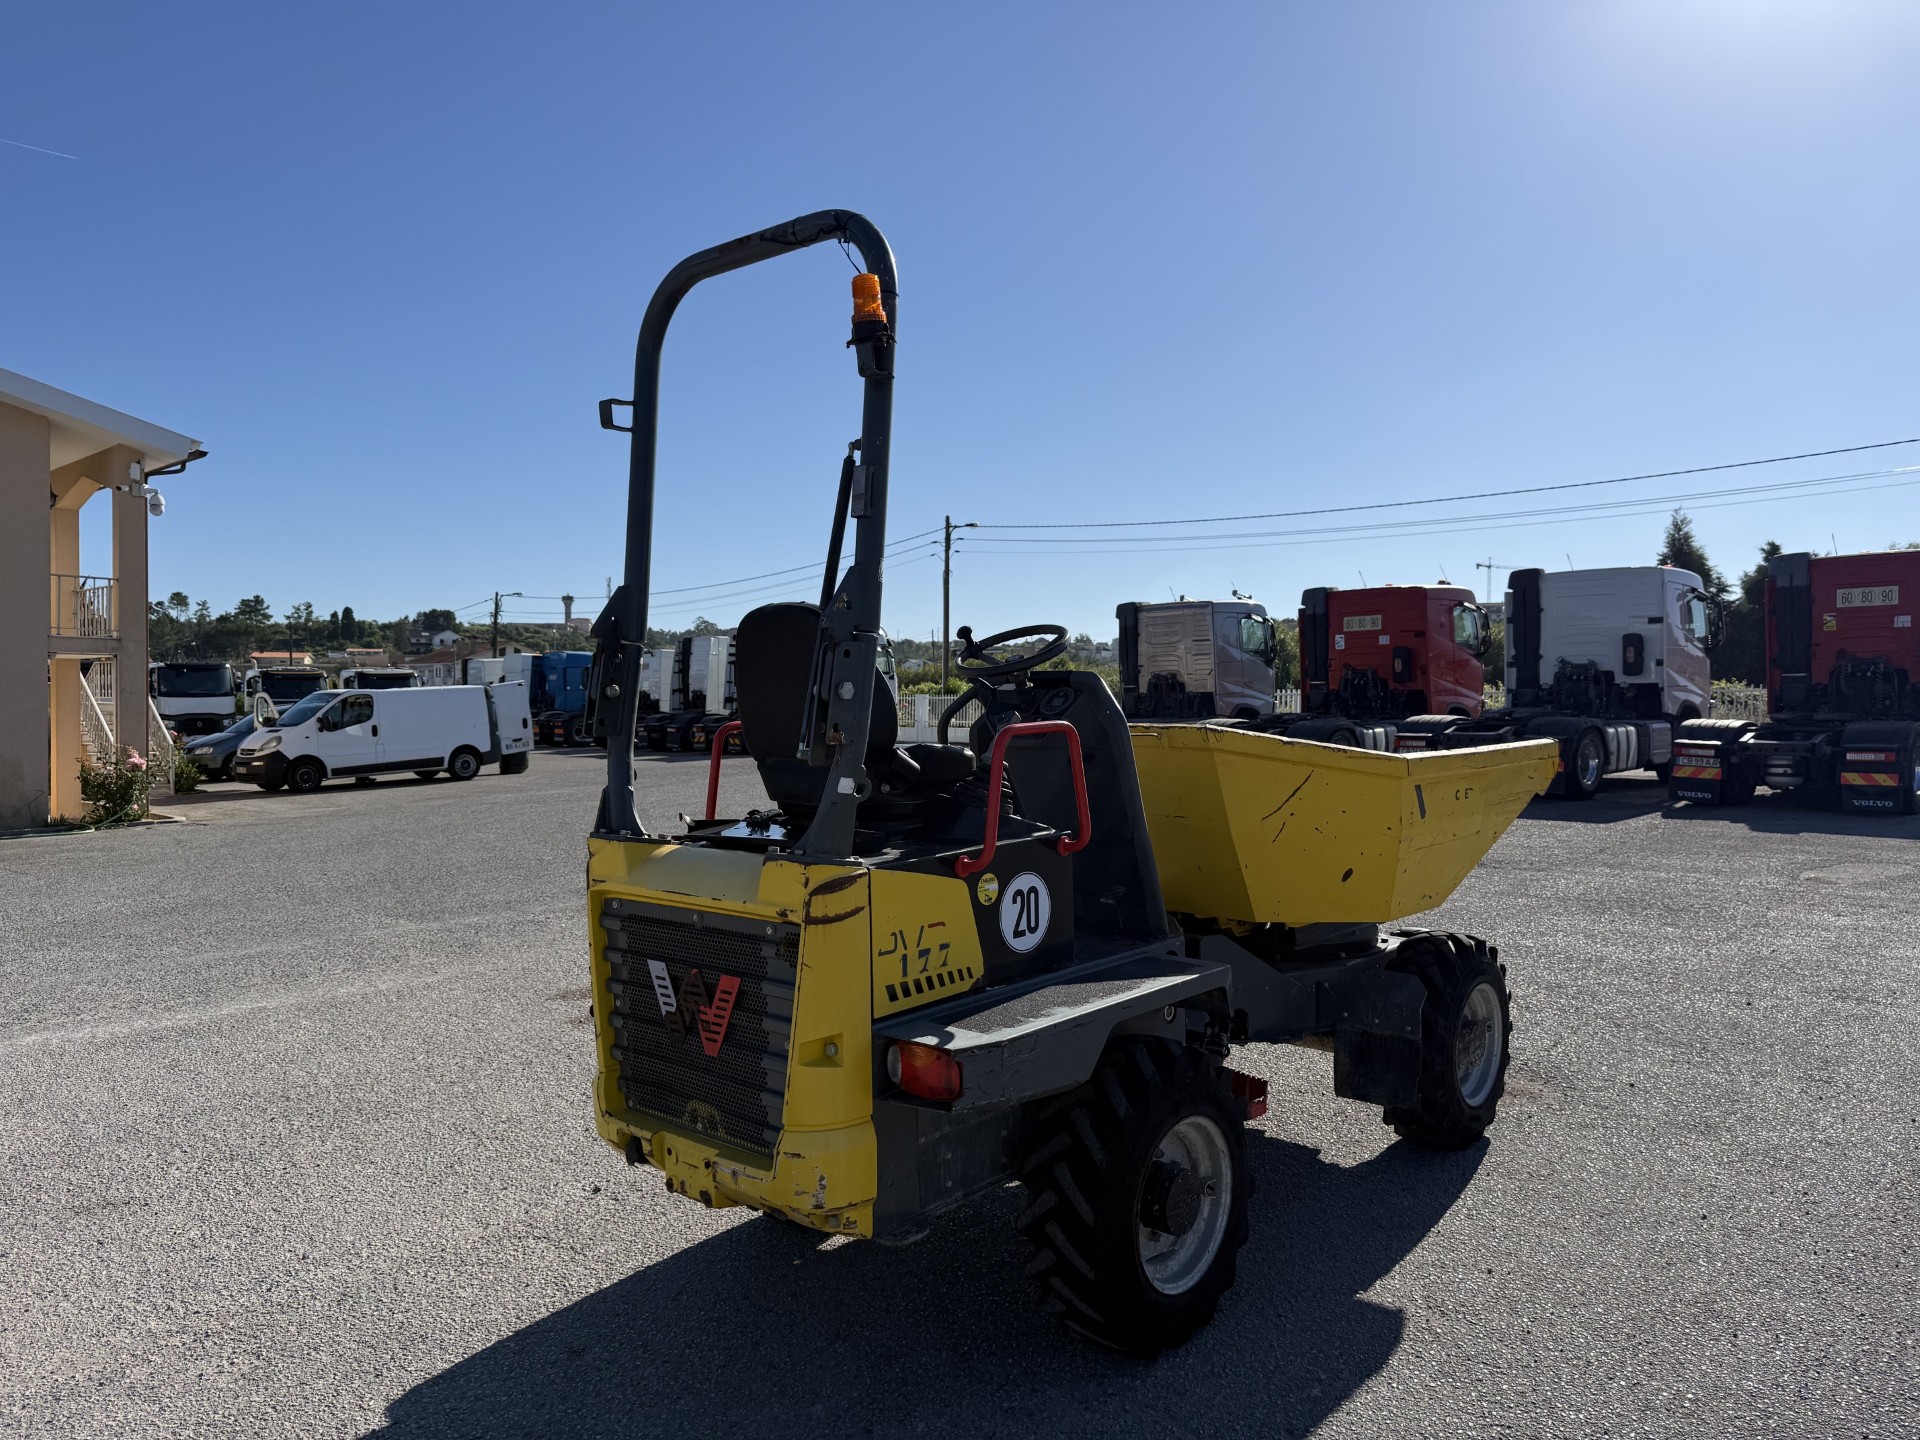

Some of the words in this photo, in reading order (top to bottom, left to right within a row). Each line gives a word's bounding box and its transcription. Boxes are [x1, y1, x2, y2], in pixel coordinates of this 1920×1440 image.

[1841, 592, 1853, 604] 60
[1861, 591, 1873, 603] 80
[1881, 589, 1893, 602] 90
[1370, 616, 1379, 628] 90
[1852, 799, 1893, 807] VOLVO
[1012, 885, 1040, 939] 20
